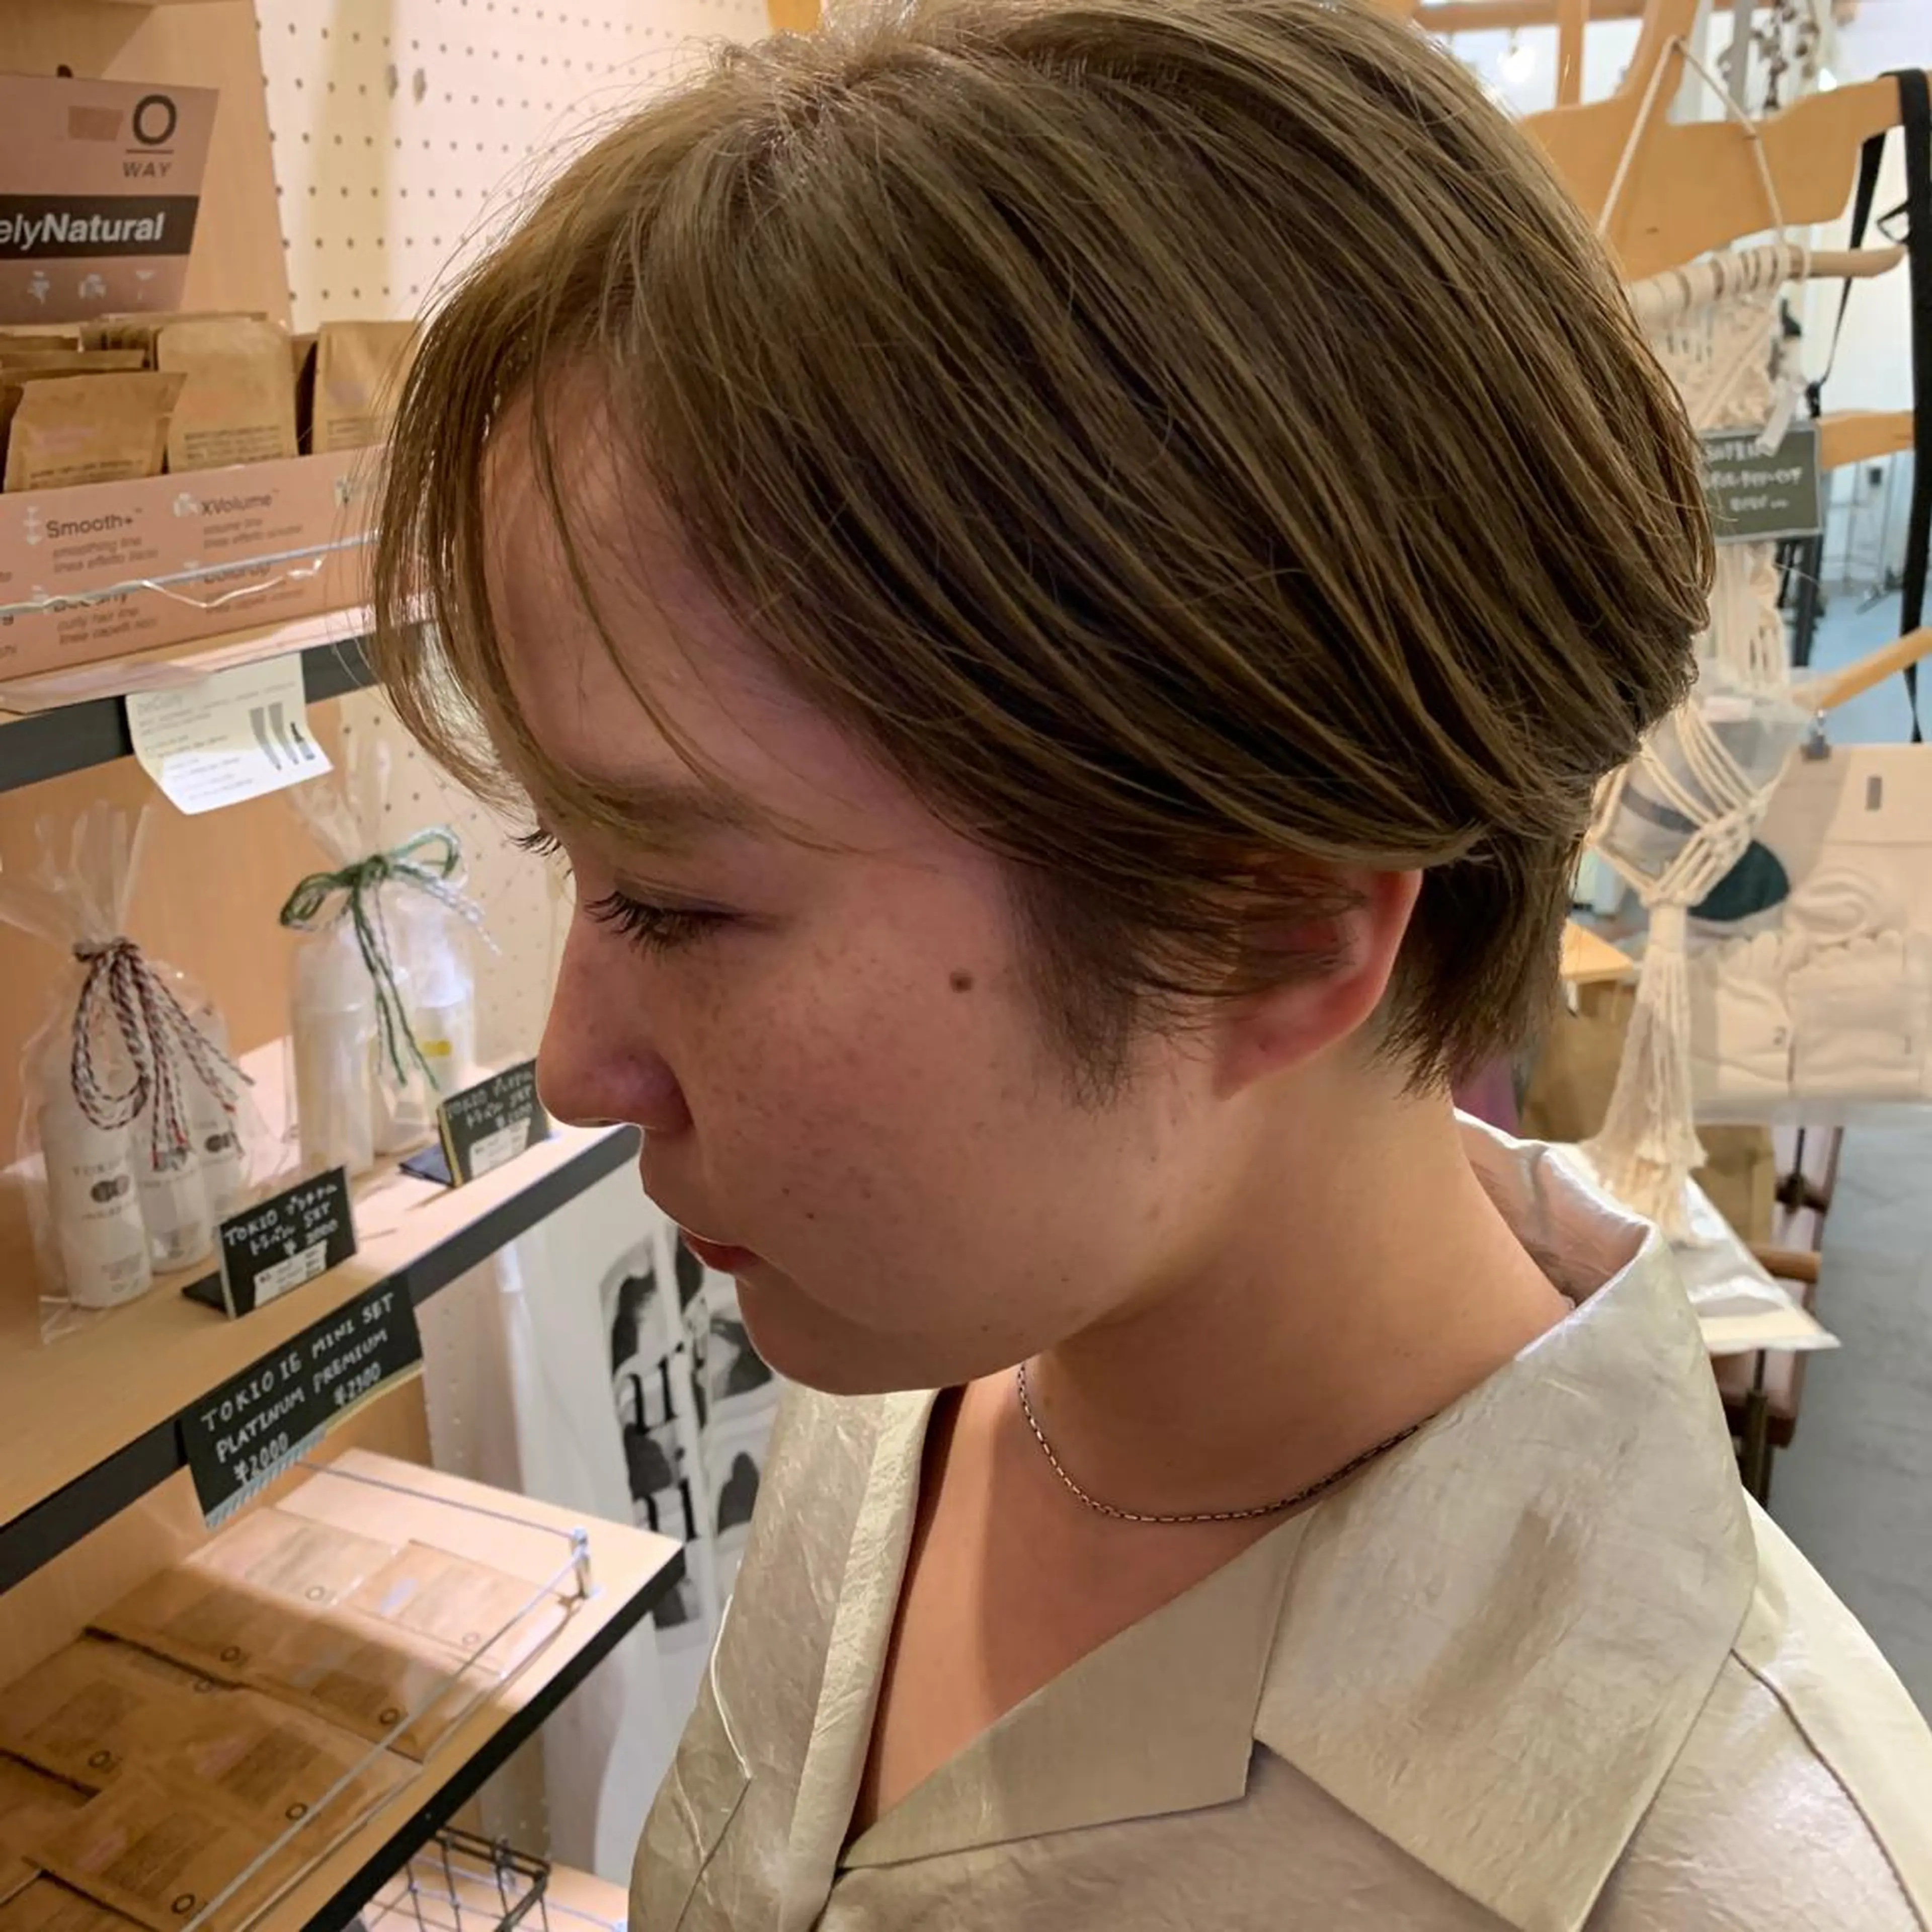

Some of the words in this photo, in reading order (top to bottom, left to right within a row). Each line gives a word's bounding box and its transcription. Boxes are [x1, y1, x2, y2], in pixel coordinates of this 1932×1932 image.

[123, 162, 172, 178] WAY
[0, 212, 166, 251] elyNatural
[224, 1209, 278, 1246] TOKIO
[201, 1370, 275, 1431] TOKIO
[278, 1351, 302, 1381] IE
[310, 1319, 355, 1359] MINI
[361, 1292, 394, 1325] SET
[215, 1386, 306, 1463] PLATINUM
[312, 1327, 388, 1394] PREMIUM
